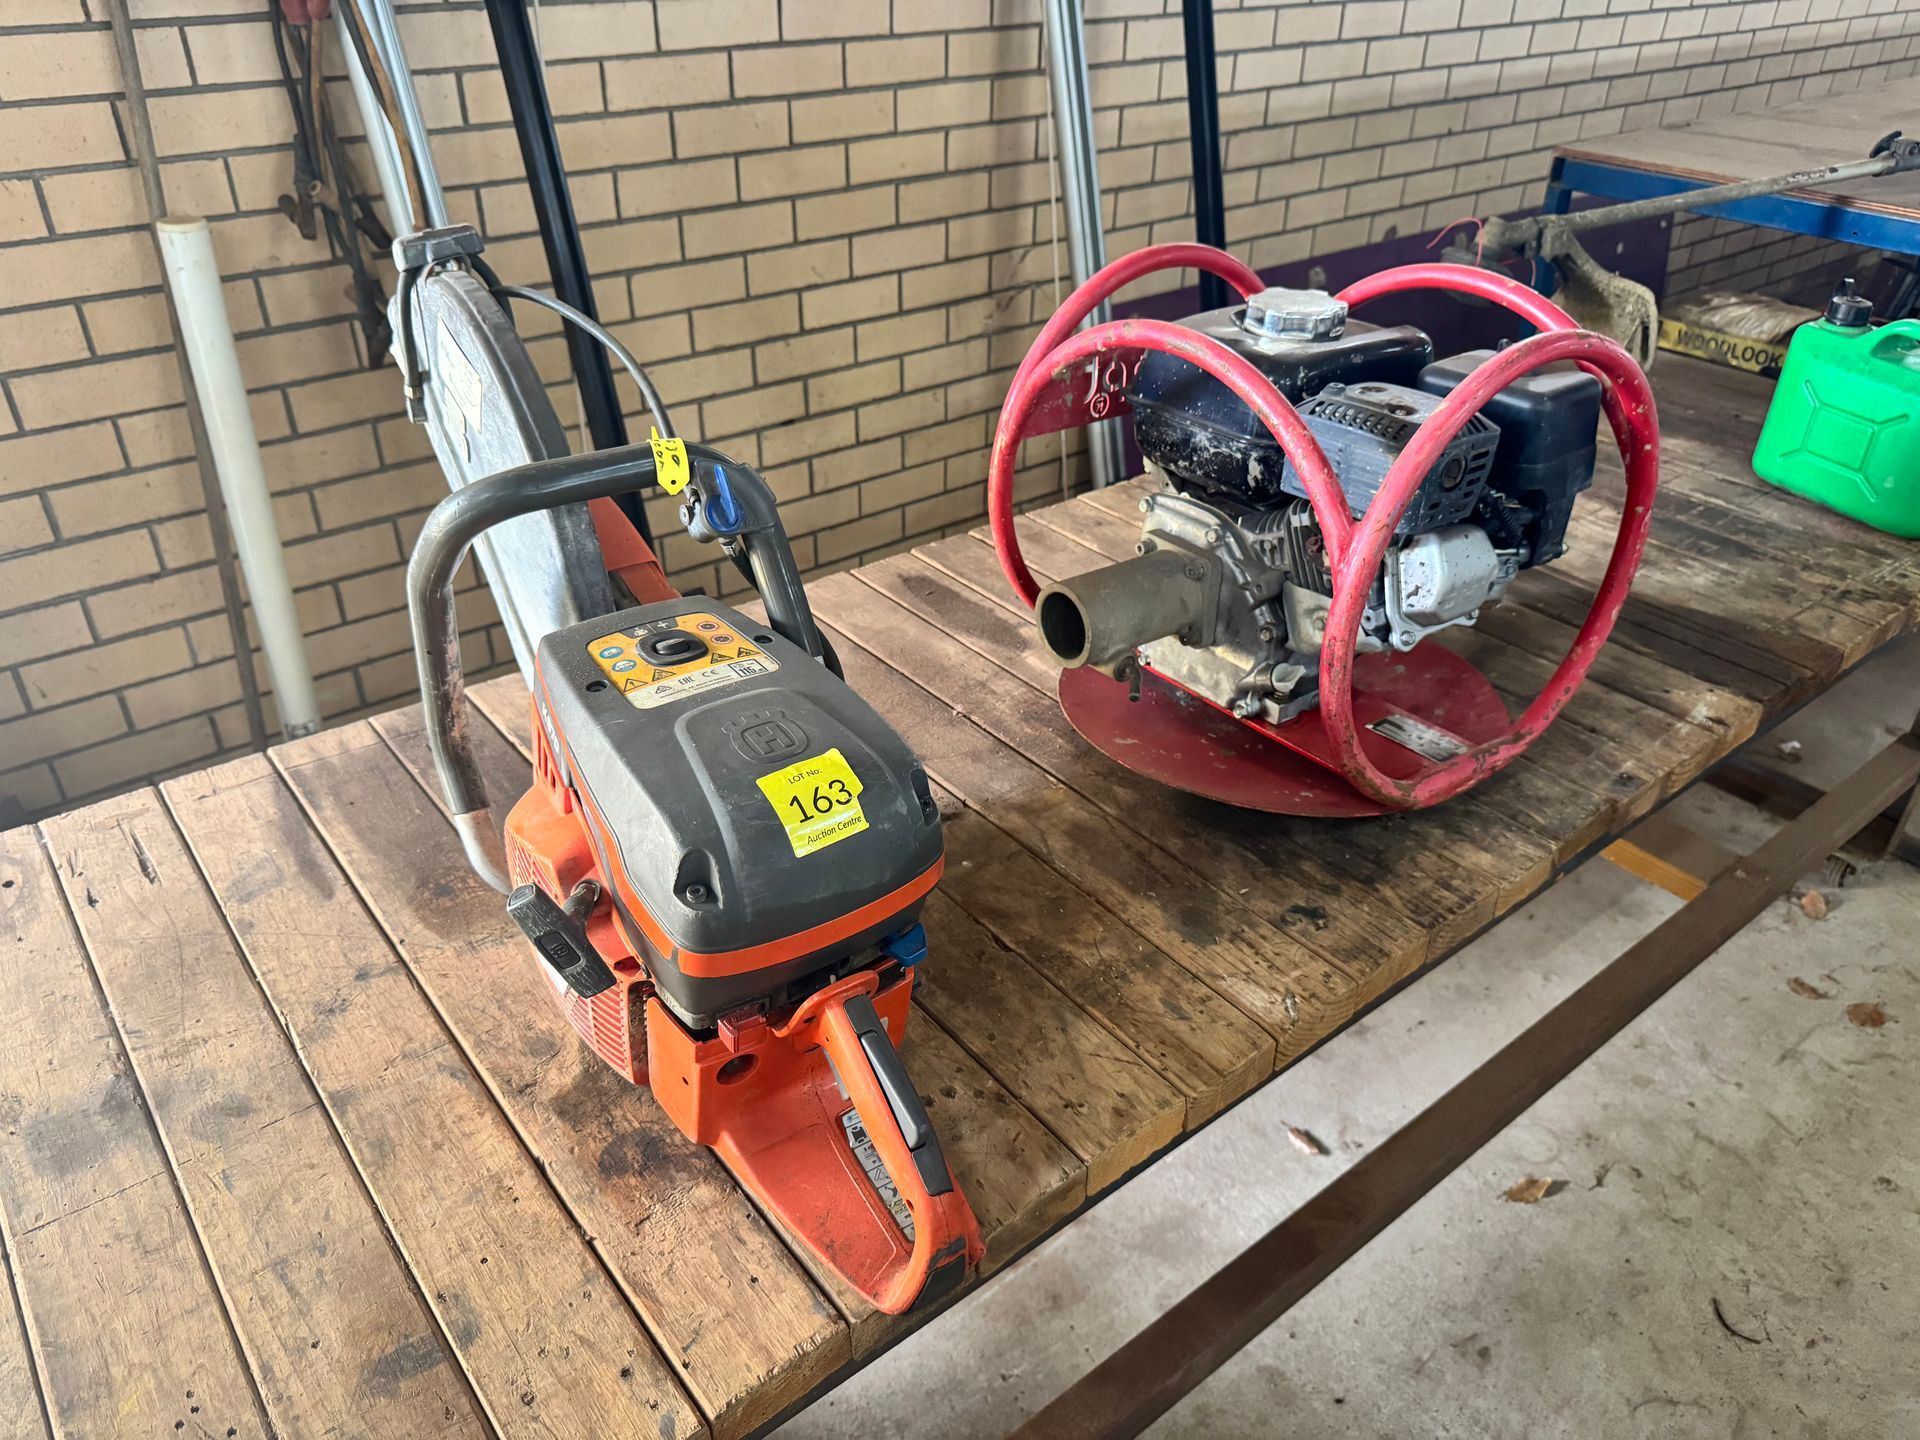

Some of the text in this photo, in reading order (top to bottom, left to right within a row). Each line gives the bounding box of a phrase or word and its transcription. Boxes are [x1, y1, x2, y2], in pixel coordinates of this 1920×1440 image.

[739, 666, 757, 677] 115
[788, 773, 805, 785] LOT
[789, 779, 853, 824] 163
[806, 815, 863, 845] Auction Centre
